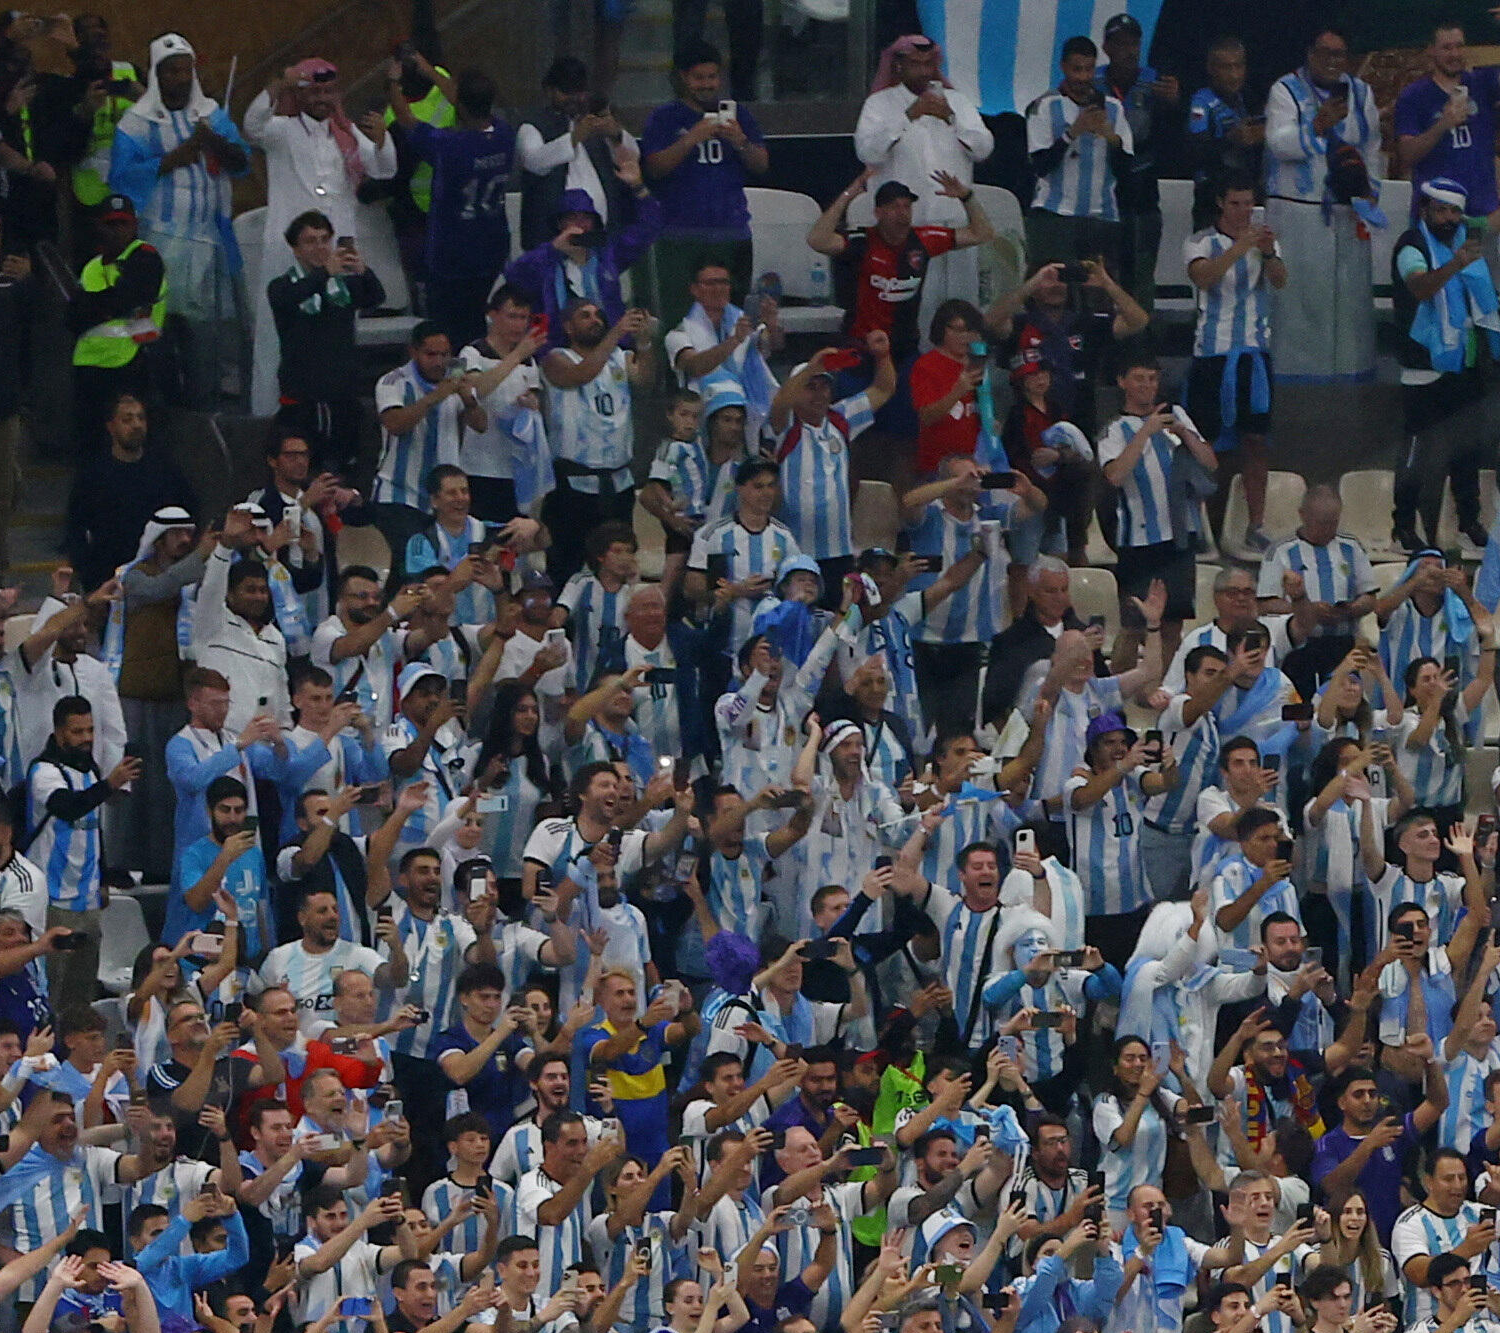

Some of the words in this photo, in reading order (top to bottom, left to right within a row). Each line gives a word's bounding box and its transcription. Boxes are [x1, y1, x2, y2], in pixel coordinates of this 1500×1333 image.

[1451, 125, 1470, 149] 10
[696, 140, 722, 163] 10
[596, 393, 615, 416] 10
[1112, 813, 1133, 837] 10
